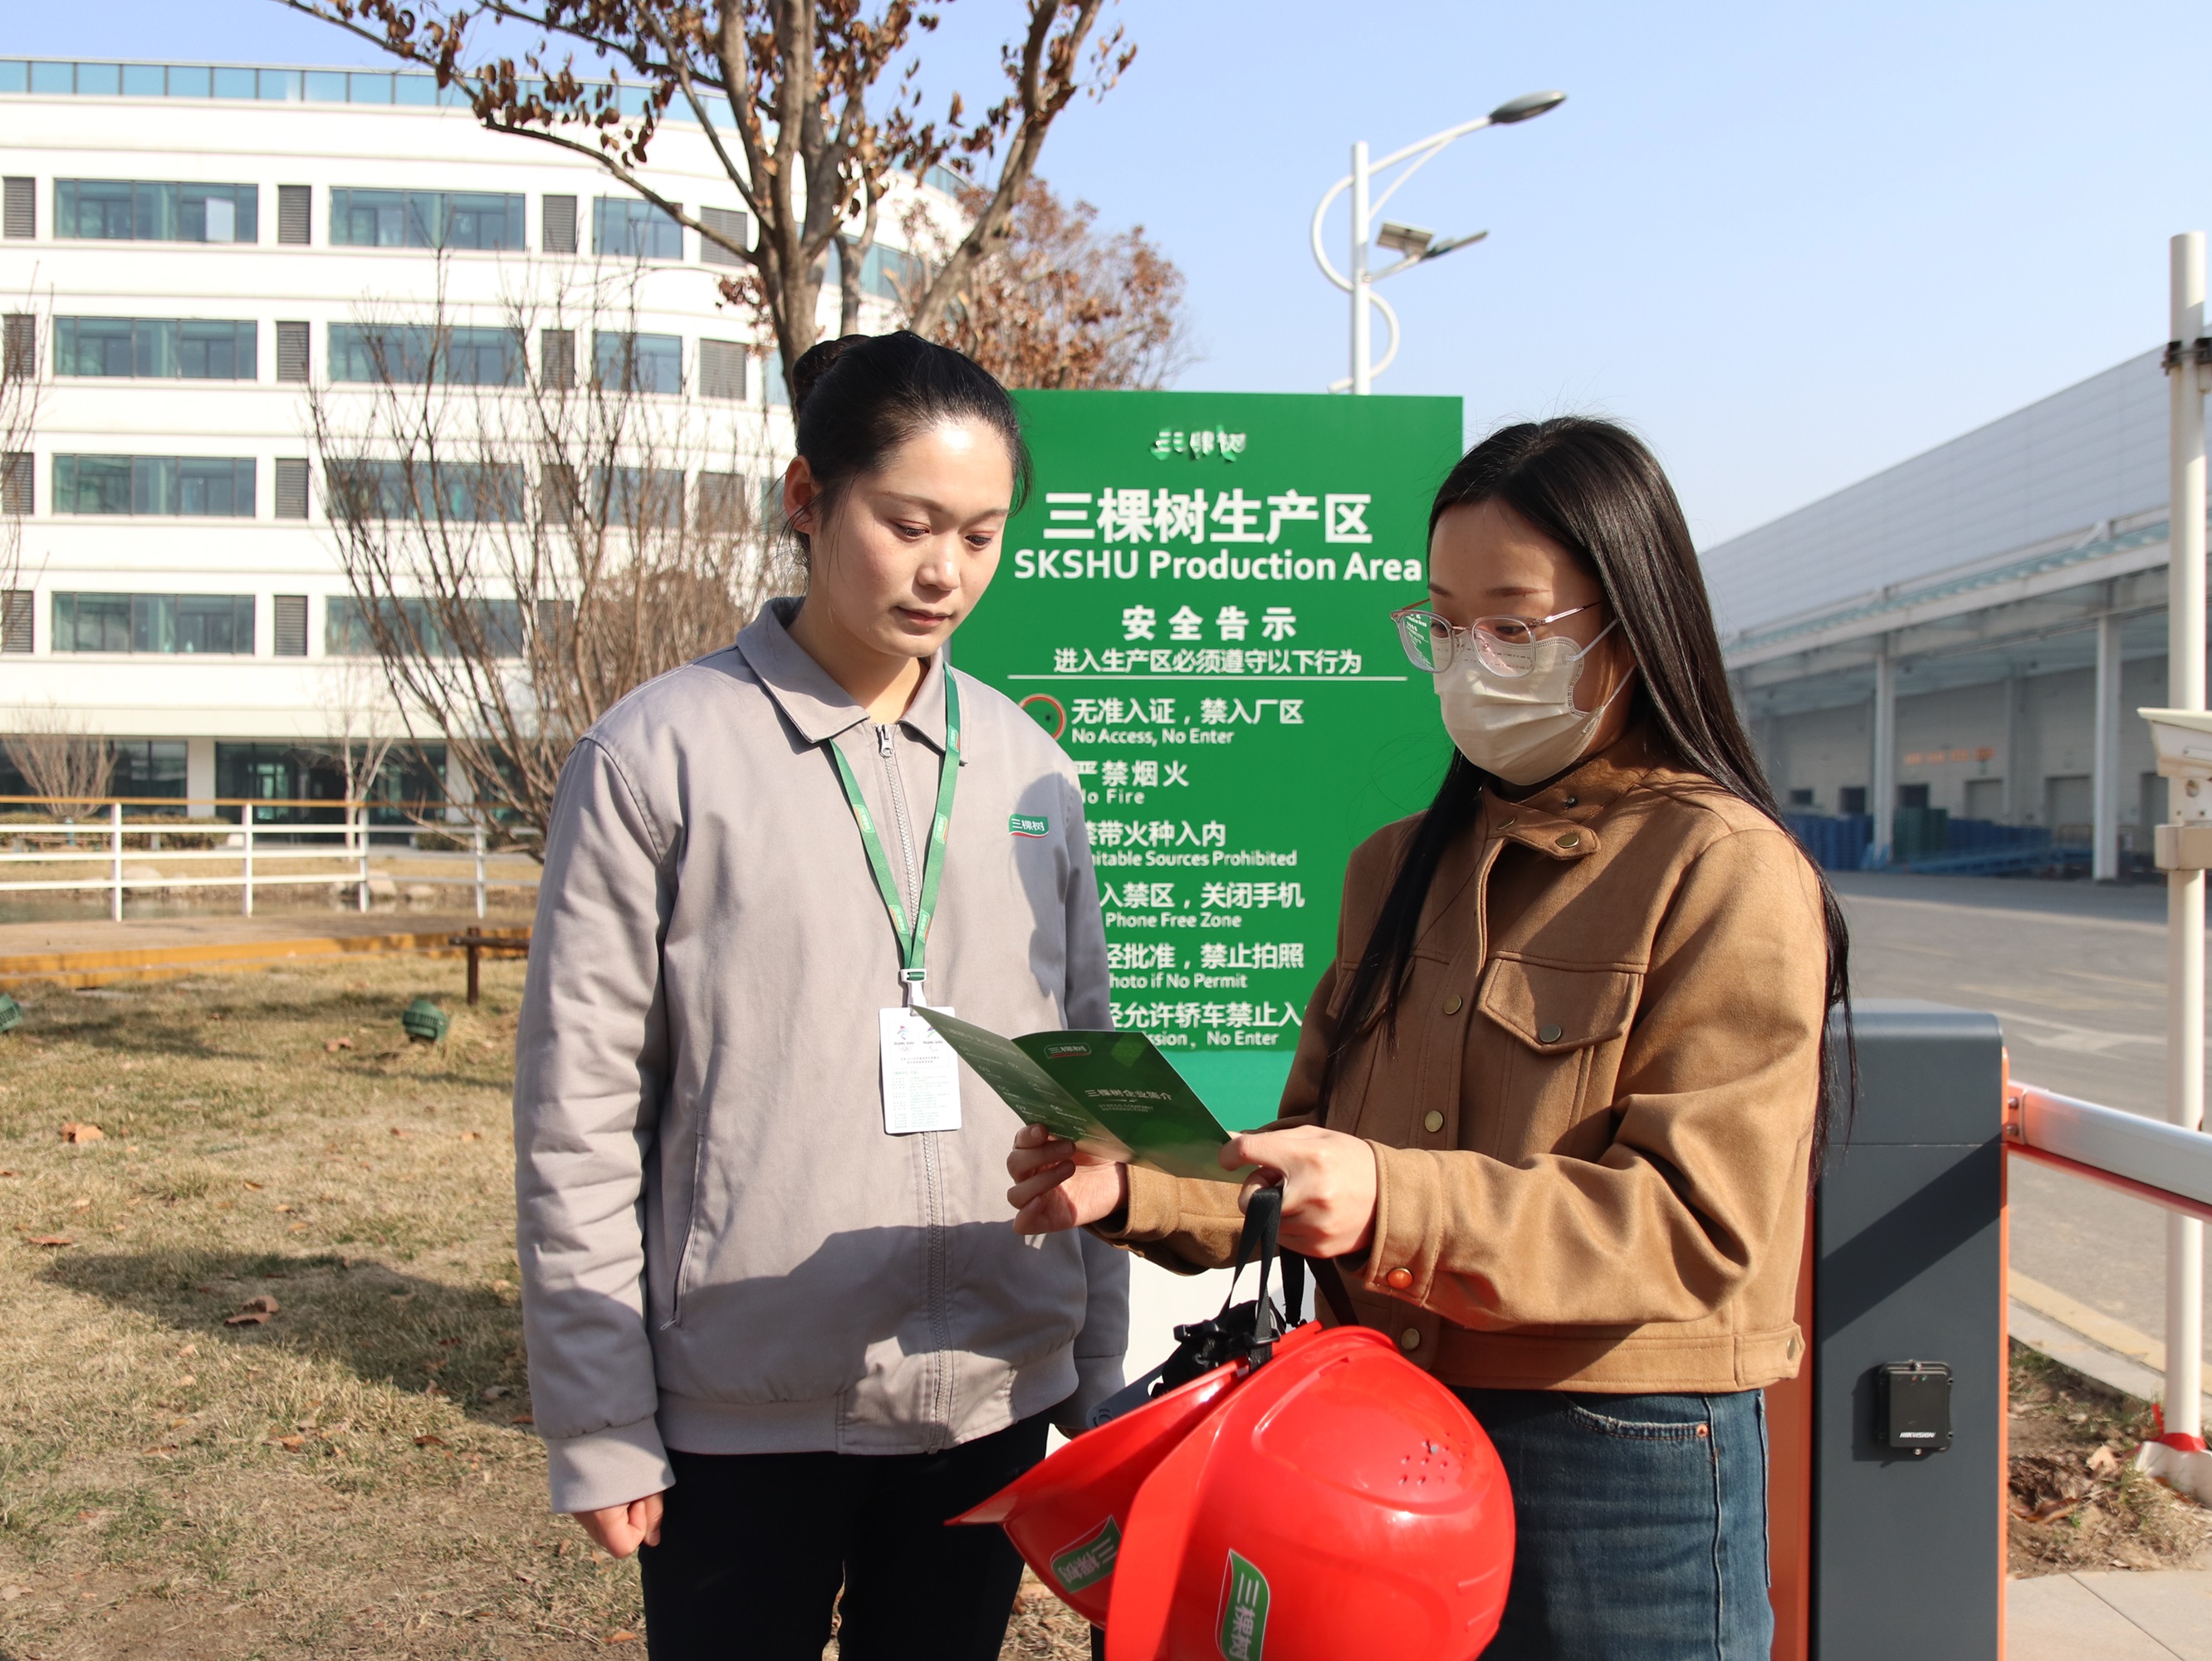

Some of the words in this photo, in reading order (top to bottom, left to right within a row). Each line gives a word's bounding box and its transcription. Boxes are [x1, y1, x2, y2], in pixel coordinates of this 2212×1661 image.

[1043, 487, 1373, 545] 三棵树生产区
[1014, 550, 1139, 580] SKSHU
[1149, 549, 1337, 581] Production
[1343, 551, 1422, 582] Area
[1121, 605, 1297, 642] 安全告示
[1053, 647, 1363, 676] 进入生产区必须遵守以下行为
[1070, 697, 1304, 725] 无准入证，禁入厂区
[1071, 728, 1097, 744] No
[1097, 728, 1158, 747] Access,
[1162, 728, 1187, 744] No
[1189, 728, 1235, 744] Enter
[1073, 759, 1190, 788] 严禁烟火
[1106, 788, 1145, 805] Fire
[1011, 818, 1045, 831] 三棵树
[1145, 850, 1211, 867] Sources
[1212, 850, 1298, 867] Prohibited
[1105, 912, 1158, 928] Phone
[1160, 912, 1197, 928] Free
[1200, 912, 1243, 928] Zone
[1110, 972, 1148, 989] hoto
[1150, 972, 1164, 988] if
[1166, 973, 1191, 989] No
[1193, 973, 1249, 989] Permit
[1109, 1001, 1307, 1029] 允许轿车禁止入
[1206, 1031, 1231, 1046] No
[1234, 1031, 1280, 1046] Enter
[1084, 1088, 1172, 1101] 三棵树企业简介
